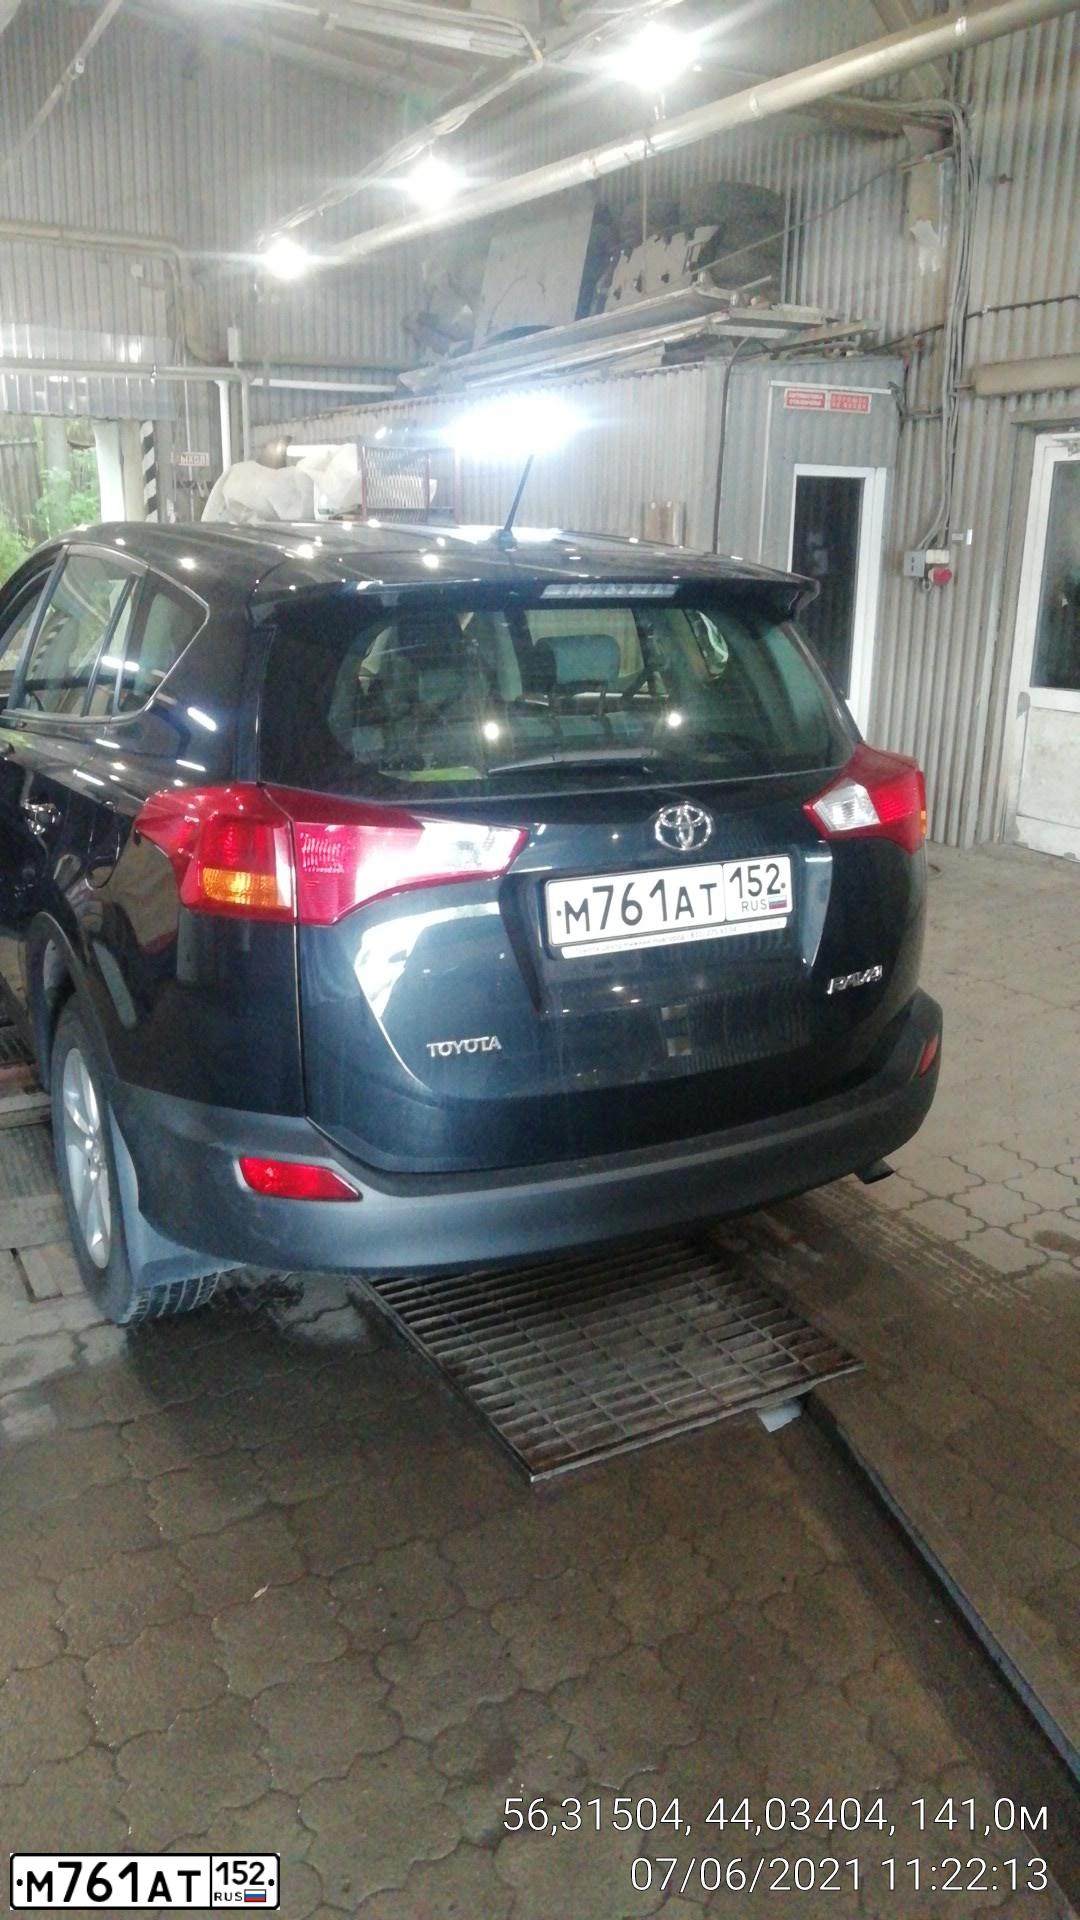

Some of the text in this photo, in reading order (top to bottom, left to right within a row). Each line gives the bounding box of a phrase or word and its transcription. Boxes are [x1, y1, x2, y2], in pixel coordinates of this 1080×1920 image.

[729, 863, 781, 899] 152
[741, 899, 768, 912] RUS
[426, 1035, 502, 1058] TOYOTA
